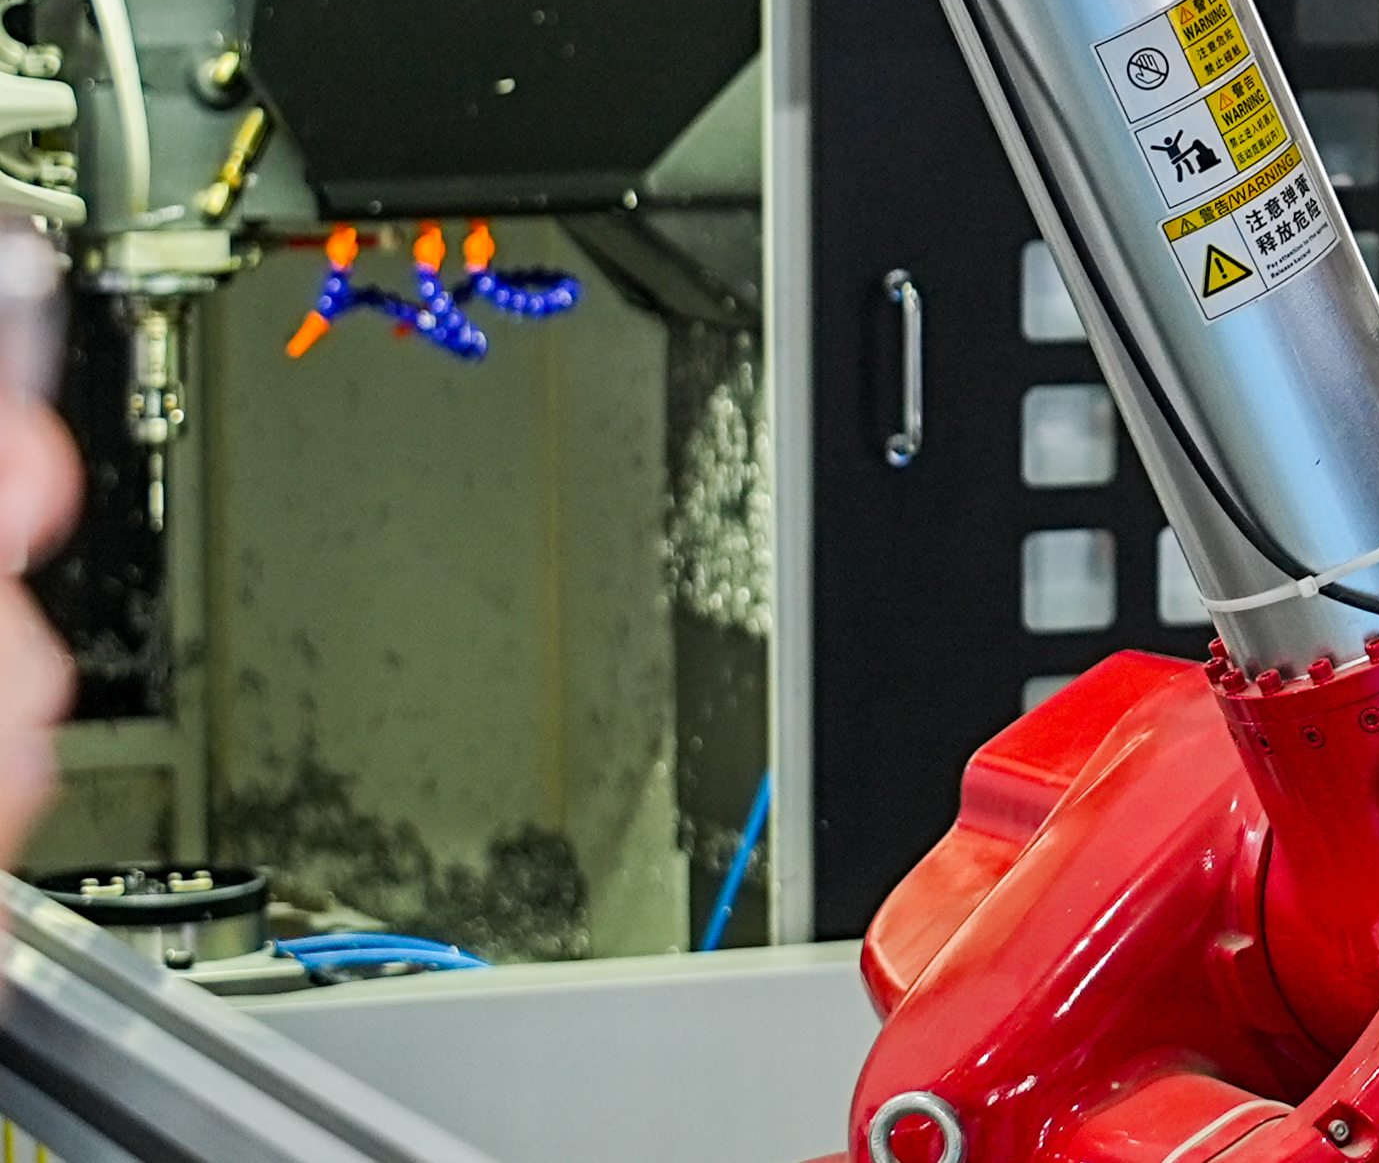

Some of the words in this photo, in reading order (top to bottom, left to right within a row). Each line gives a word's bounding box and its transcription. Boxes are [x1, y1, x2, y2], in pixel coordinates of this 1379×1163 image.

[1182, 4, 1227, 41] WARNING
[1231, 75, 1255, 99] 警告
[1221, 89, 1265, 127] WARNING
[1245, 173, 1311, 233] 注意弹簧
[1255, 197, 1321, 256] 释放危险
